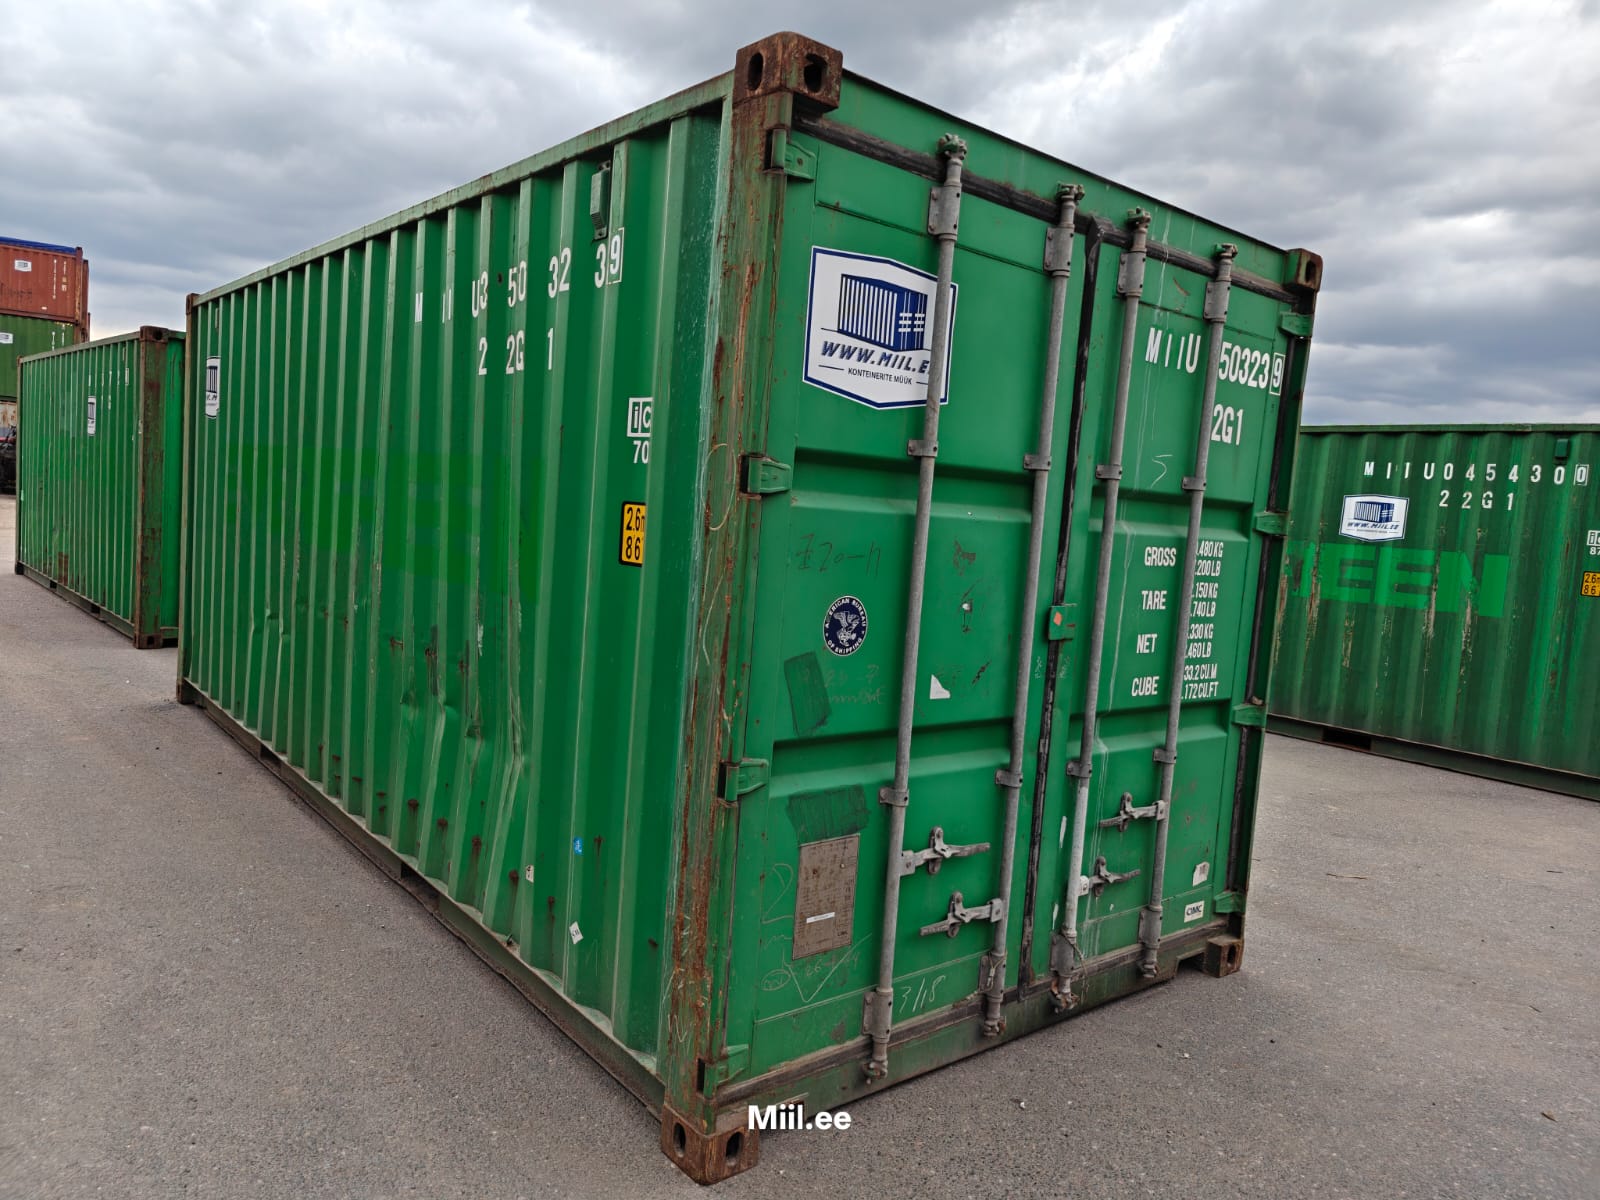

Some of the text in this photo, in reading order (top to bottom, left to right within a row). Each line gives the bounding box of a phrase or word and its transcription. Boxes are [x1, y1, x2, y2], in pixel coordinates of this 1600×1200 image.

[820, 340, 931, 375] WWW.MIIL.E
[1145, 327, 1202, 374] MIIU
[847, 367, 893, 382] KONTEINERITE
[1211, 404, 1244, 446] 2G1
[633, 440, 649, 464] 70
[1144, 540, 1224, 567] GROSS .480 KG
[1194, 559, 1221, 577] .200 LB
[1141, 582, 1219, 610] TARE .150 KG
[1190, 601, 1216, 618] .740 LB
[1136, 623, 1214, 654] NET .330 KG
[1184, 642, 1212, 659] .460 LB
[1131, 676, 1160, 697] CUBE
[1180, 683, 1198, 700] .172
